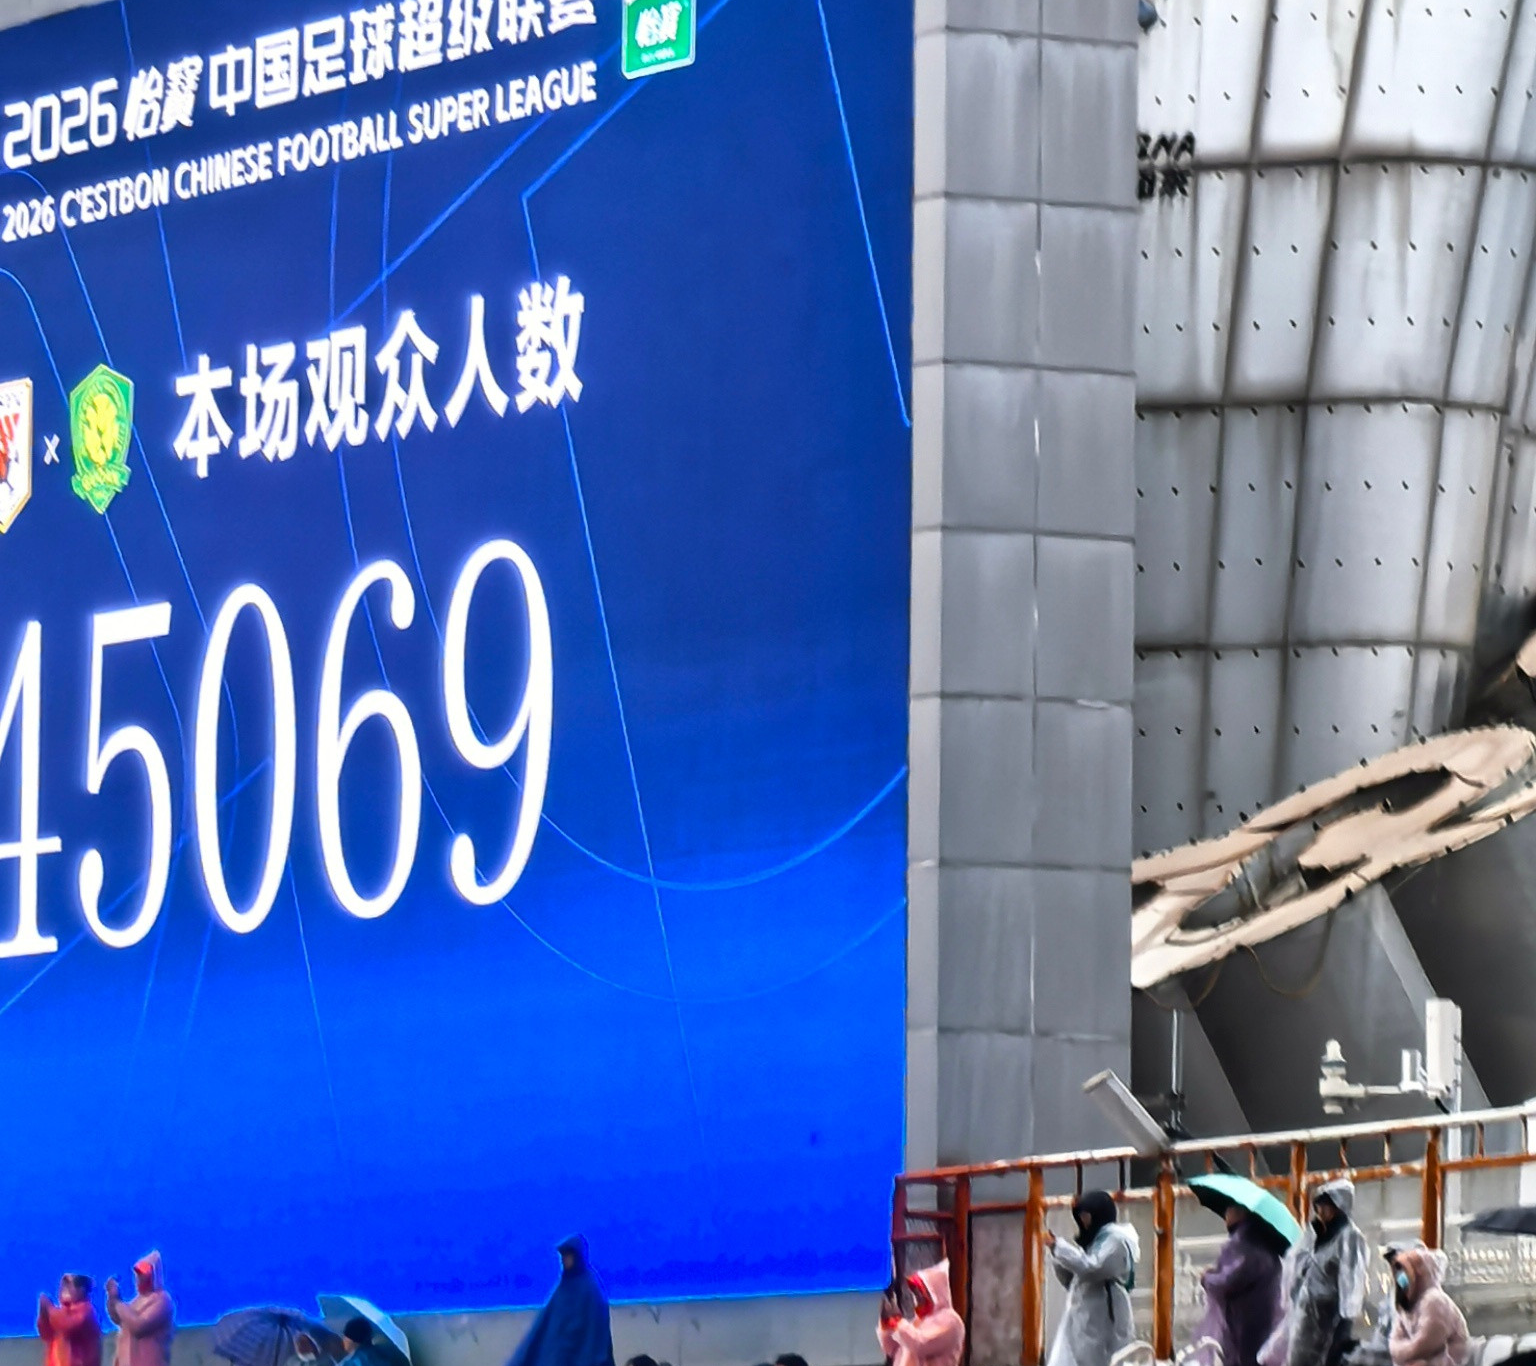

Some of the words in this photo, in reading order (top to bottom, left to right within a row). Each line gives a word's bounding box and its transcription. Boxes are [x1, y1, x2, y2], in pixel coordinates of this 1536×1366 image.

[2, 195, 56, 243] 2026
[59, 167, 170, 228] C'ESTBON
[174, 141, 274, 200] CHINESE
[277, 109, 404, 176] FOOTBALL
[407, 89, 490, 144] SUPER
[494, 60, 597, 124] LEAGUE
[173, 276, 585, 479] 本场观众人数
